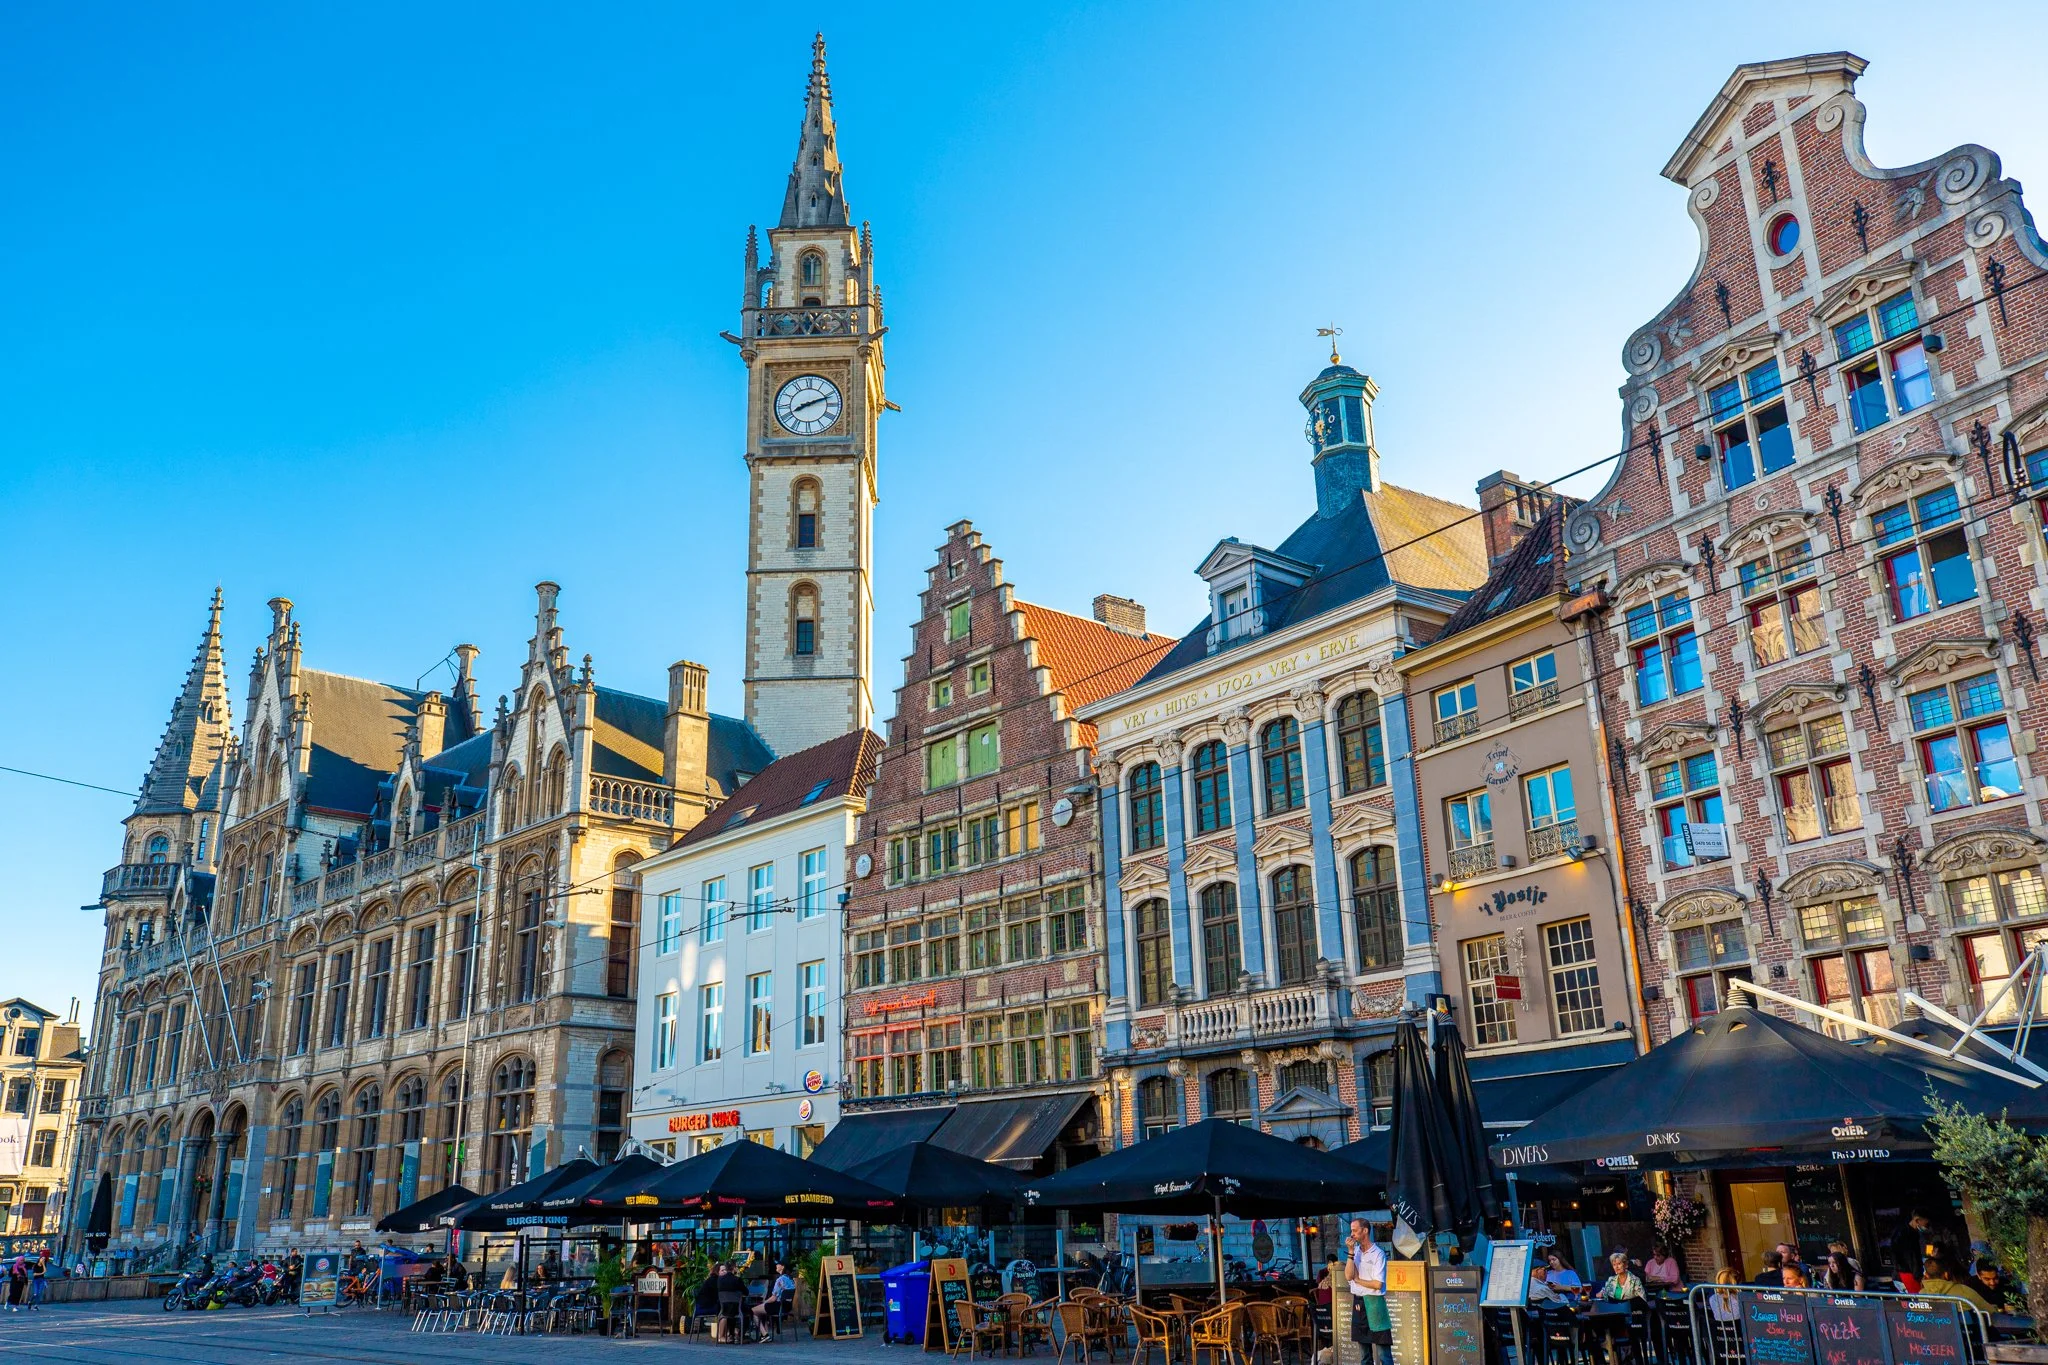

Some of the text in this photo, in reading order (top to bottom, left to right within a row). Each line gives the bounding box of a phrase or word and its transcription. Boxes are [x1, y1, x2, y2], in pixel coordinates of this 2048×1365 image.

[1123, 633, 1359, 730] VRY HUYS 1702 VRY ERVE
[1486, 746, 1509, 762] Tripel
[1485, 765, 1519, 786] Karmeliet
[1682, 823, 1694, 855] TE HUUR
[1478, 884, 1548, 917] 't Postje
[807, 1074, 821, 1082] BURGER
[807, 1079, 822, 1088] KING
[668, 1109, 740, 1132] BURGER KING
[1831, 1125, 1868, 1137] OMER.
[1503, 1144, 1549, 1166] DIVERS
[1605, 1155, 1639, 1166] OMER.
[785, 1193, 834, 1205] HET DAMBERD
[1398, 1198, 1419, 1226] AITS
[506, 1215, 569, 1226] BURGER KING
[1834, 1298, 1857, 1306] OMER.
[1908, 1302, 1933, 1310] OMER.
[1780, 1308, 1803, 1323] MENU
[1819, 1315, 1861, 1341] PIZZA
[1896, 1322, 1926, 1339] Menu
[1909, 1342, 1956, 1359] MOSSELEN
